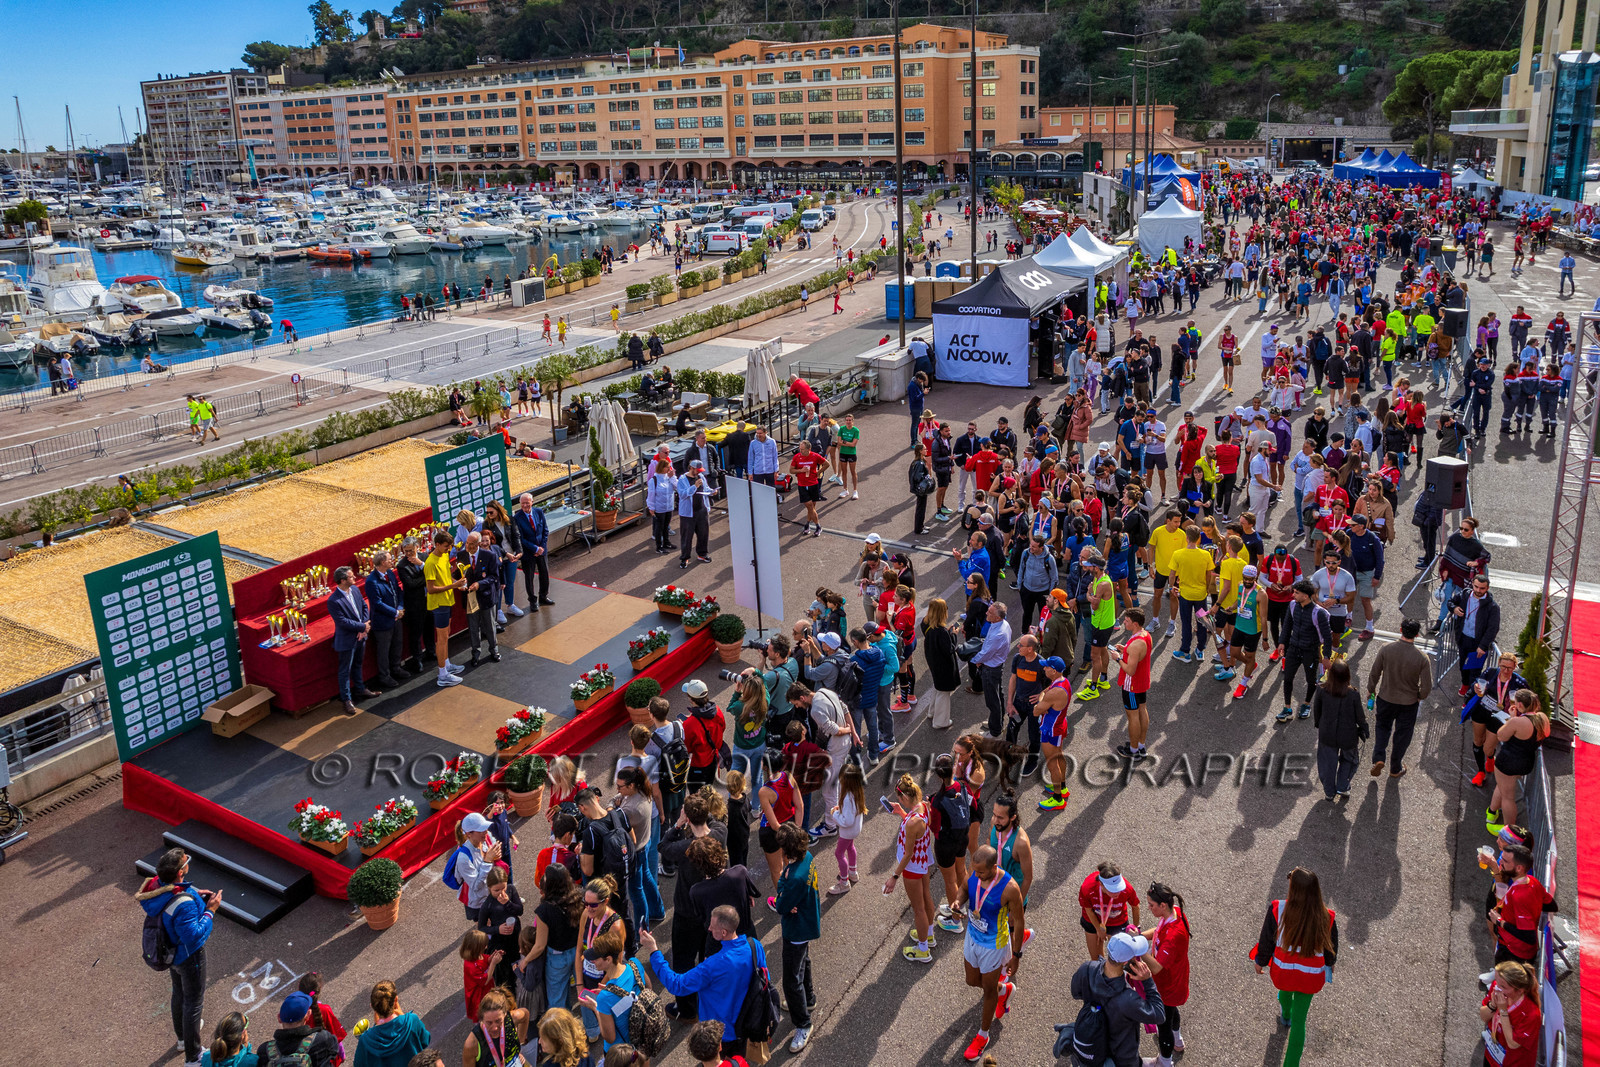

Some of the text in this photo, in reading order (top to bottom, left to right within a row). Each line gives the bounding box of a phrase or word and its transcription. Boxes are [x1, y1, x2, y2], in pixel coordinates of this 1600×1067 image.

[949, 333, 980, 347] ACT
[946, 348, 1012, 366] NOOOW.
[121, 558, 170, 582] MONACORUN
